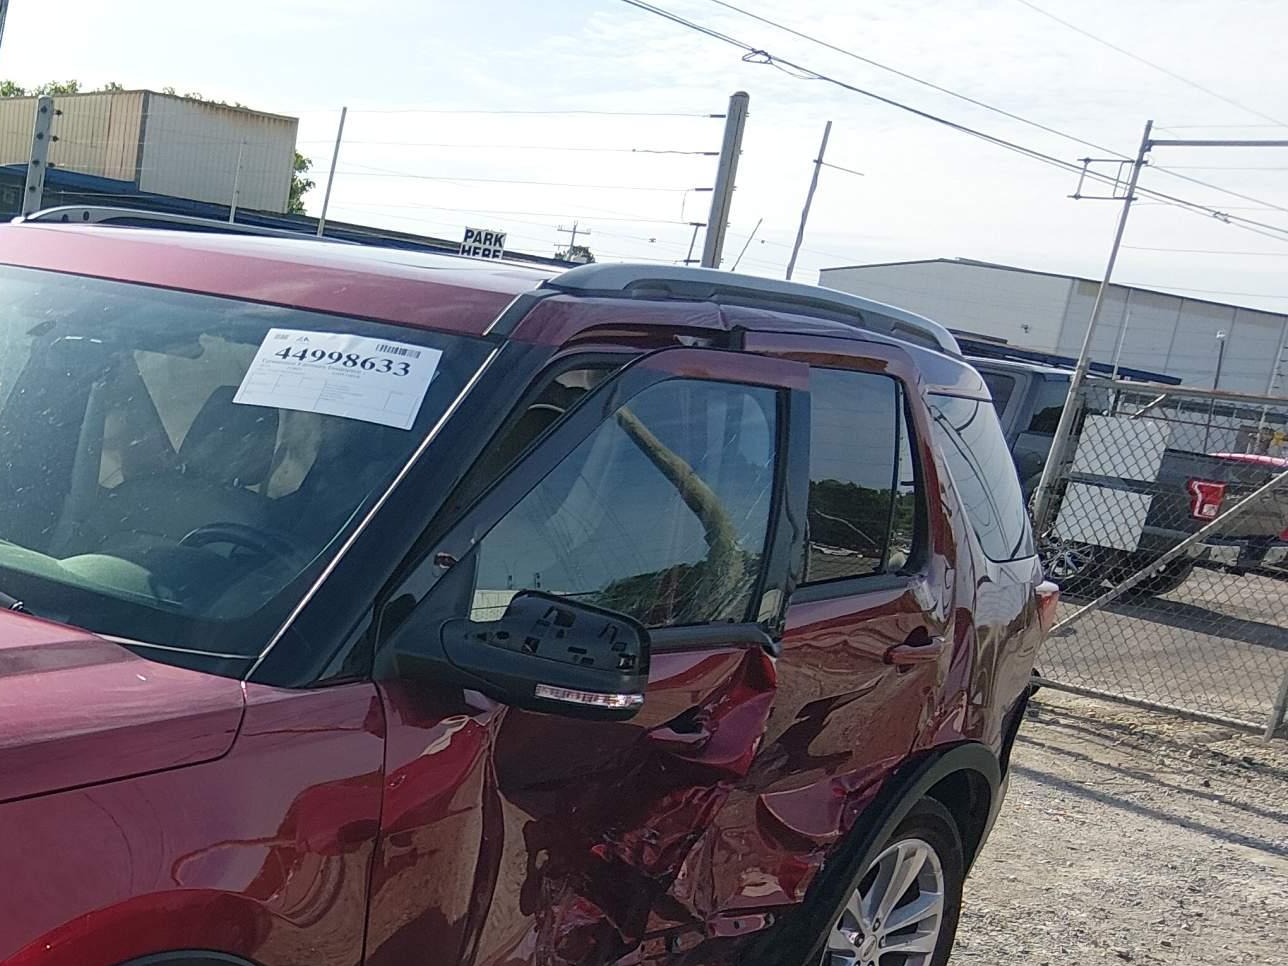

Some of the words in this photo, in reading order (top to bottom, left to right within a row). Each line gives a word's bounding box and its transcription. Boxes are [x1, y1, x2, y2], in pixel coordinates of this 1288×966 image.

[463, 228, 505, 248] PARK
[460, 244, 502, 259] HERE
[274, 345, 411, 377] 44998633
